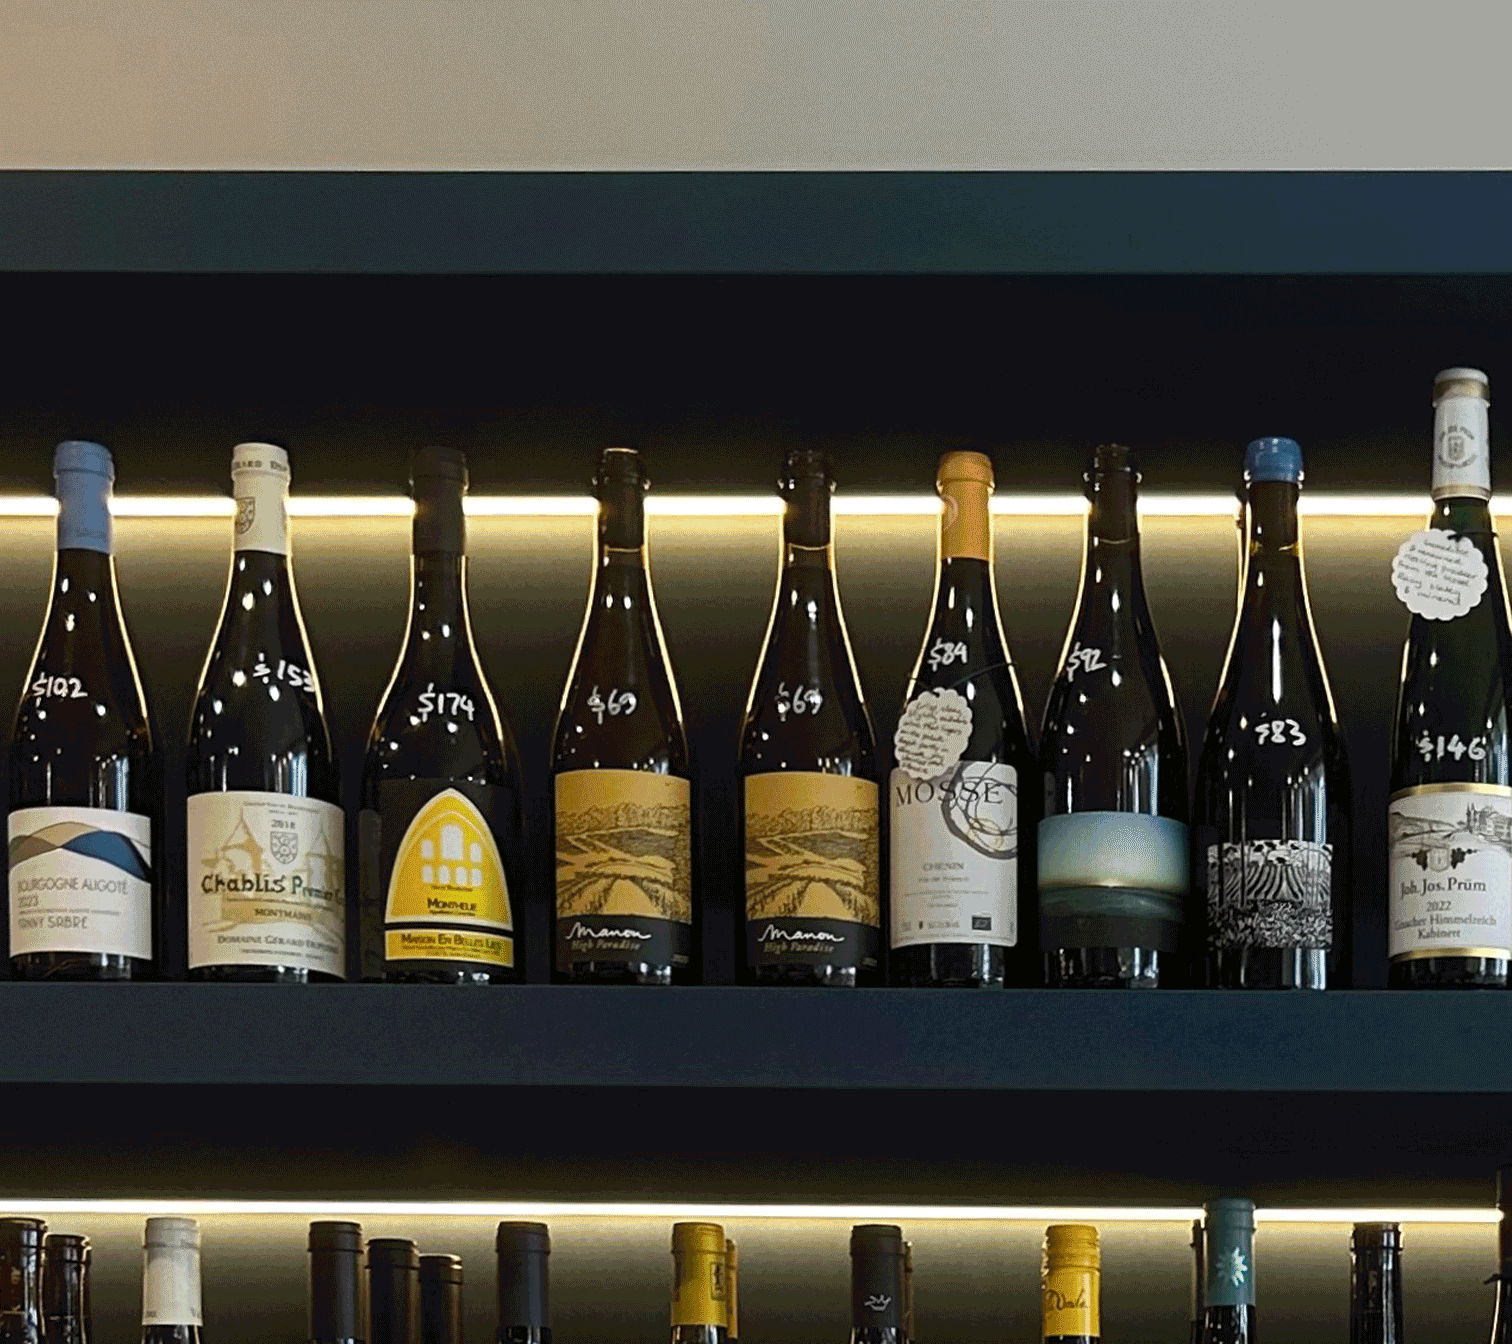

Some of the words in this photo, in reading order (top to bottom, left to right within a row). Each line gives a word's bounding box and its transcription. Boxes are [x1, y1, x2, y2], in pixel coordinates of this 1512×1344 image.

[928, 638, 968, 671] $84
[1068, 642, 1107, 682] $92
[32, 672, 88, 707] $102
[418, 682, 475, 722] $174
[587, 686, 637, 724] $69
[774, 682, 823, 722] $69
[1254, 712, 1307, 745] $83
[1417, 729, 1487, 762] $146
[896, 780, 1003, 807] MOSSE
[201, 872, 286, 895] Chablis
[1421, 879, 1446, 896] Jos.
[1448, 877, 1486, 892] Prüm
[1426, 901, 1451, 912] 2022
